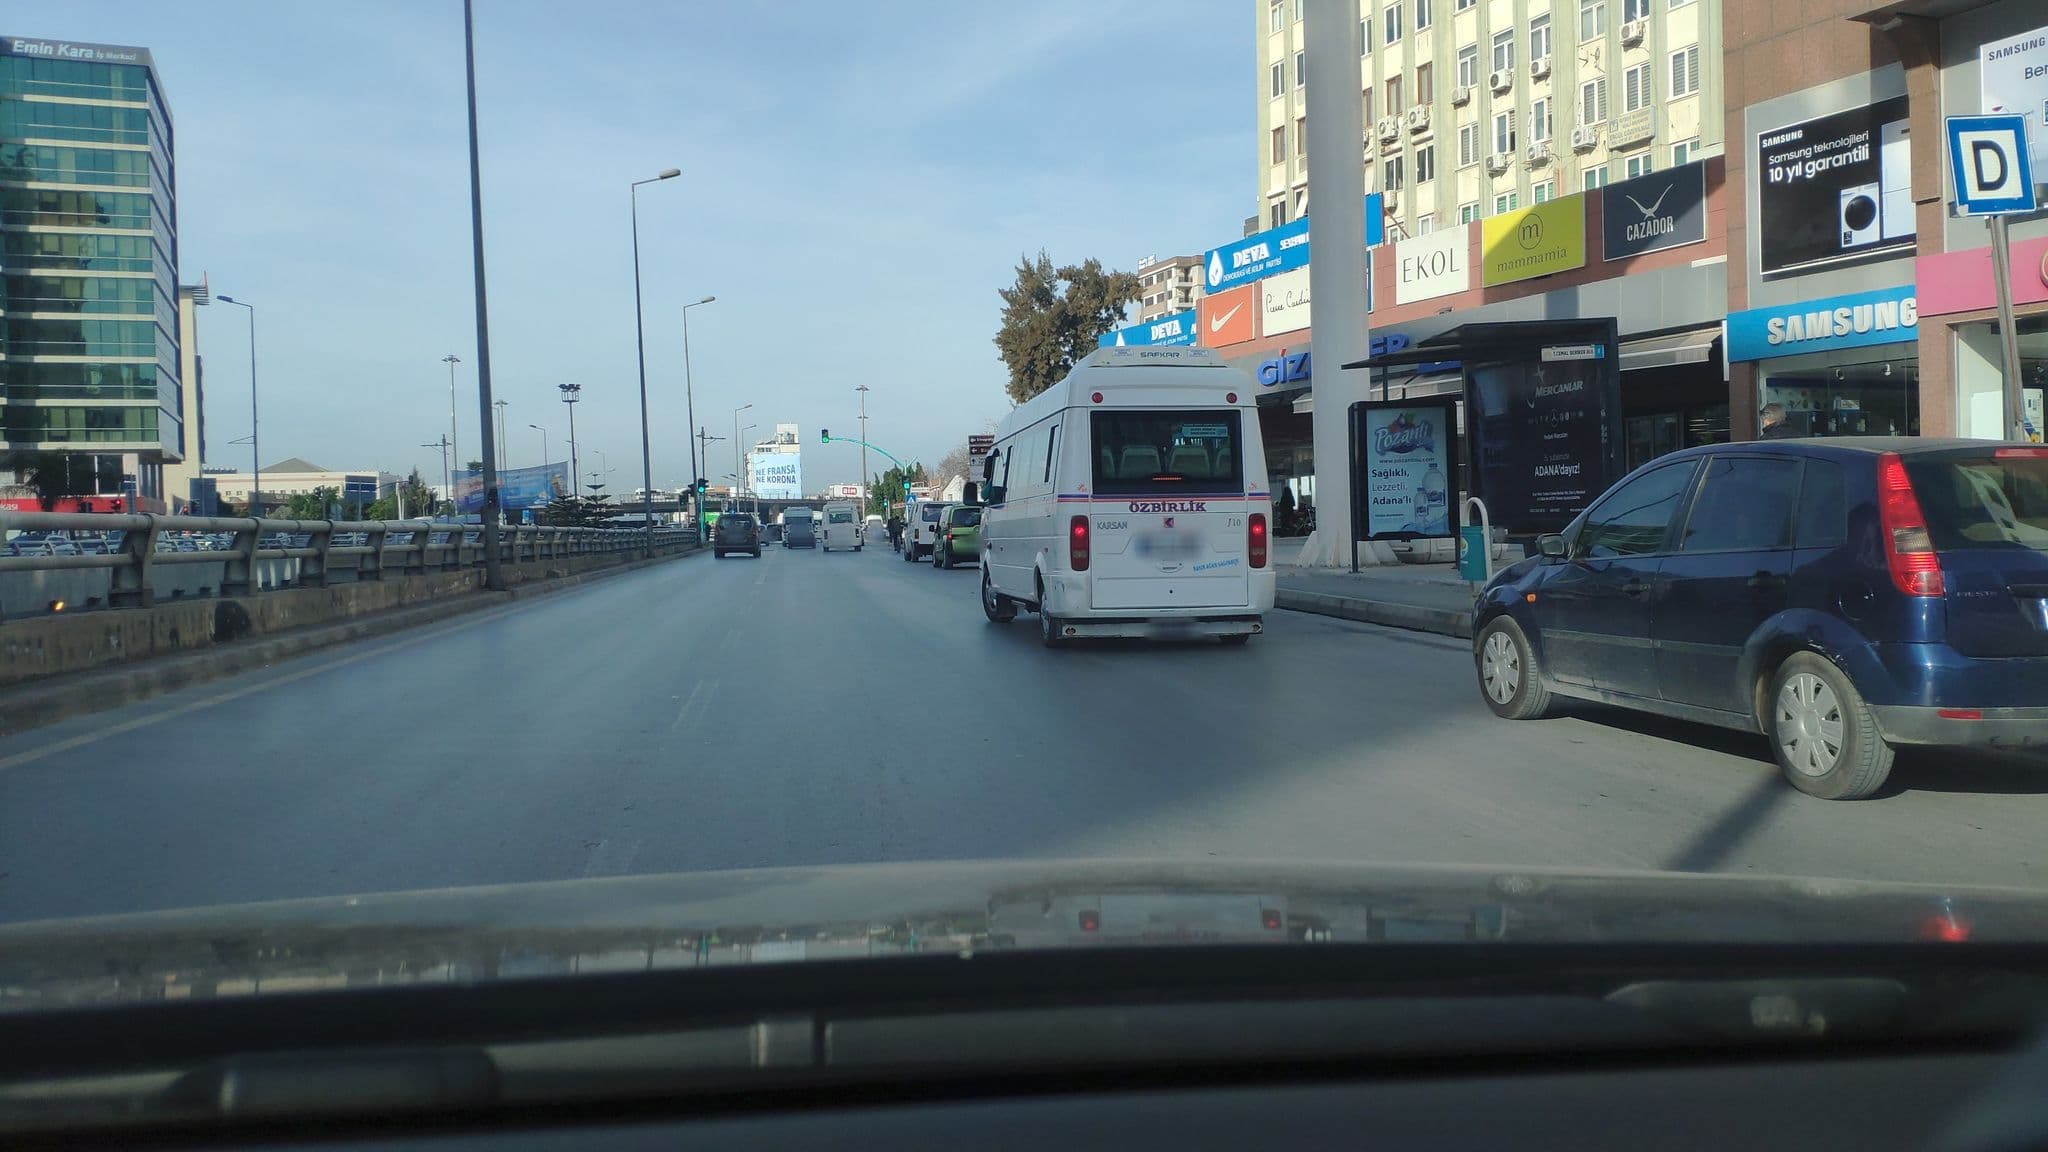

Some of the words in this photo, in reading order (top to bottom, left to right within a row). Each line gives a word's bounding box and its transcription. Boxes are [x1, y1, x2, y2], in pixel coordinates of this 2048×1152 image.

[12, 40, 53, 55] Emin
[57, 43, 94, 58] Kara
[1988, 36, 2046, 61] SAMSUNG
[1762, 130, 1803, 148] SAMSUNG
[1768, 146, 1812, 165] Samsung
[1813, 130, 1869, 154] teknolojileri
[1768, 166, 1783, 183] 10
[1785, 161, 1802, 183] yıl
[1805, 143, 1870, 179] garantili
[1971, 140, 2009, 192] D
[1626, 215, 1674, 242] CAZADOR
[1232, 242, 1270, 269] DEVA
[1402, 247, 1461, 284] EKOL
[1496, 247, 1569, 274] mammamia
[1151, 319, 1182, 341] DEVA
[1767, 297, 1919, 345] SAMSUNG
[756, 467, 767, 476] NE
[767, 464, 796, 475] FRANSA
[756, 475, 766, 483] NE
[766, 475, 797, 484] KORONA
[1371, 468, 1410, 479] Sağlıklı,
[1534, 462, 1580, 477] ADANA'dayız!
[1128, 501, 1207, 513] ÖZBİRLİK
[1372, 495, 1412, 505] Adana'lı
[1096, 521, 1128, 530] KARSAN
